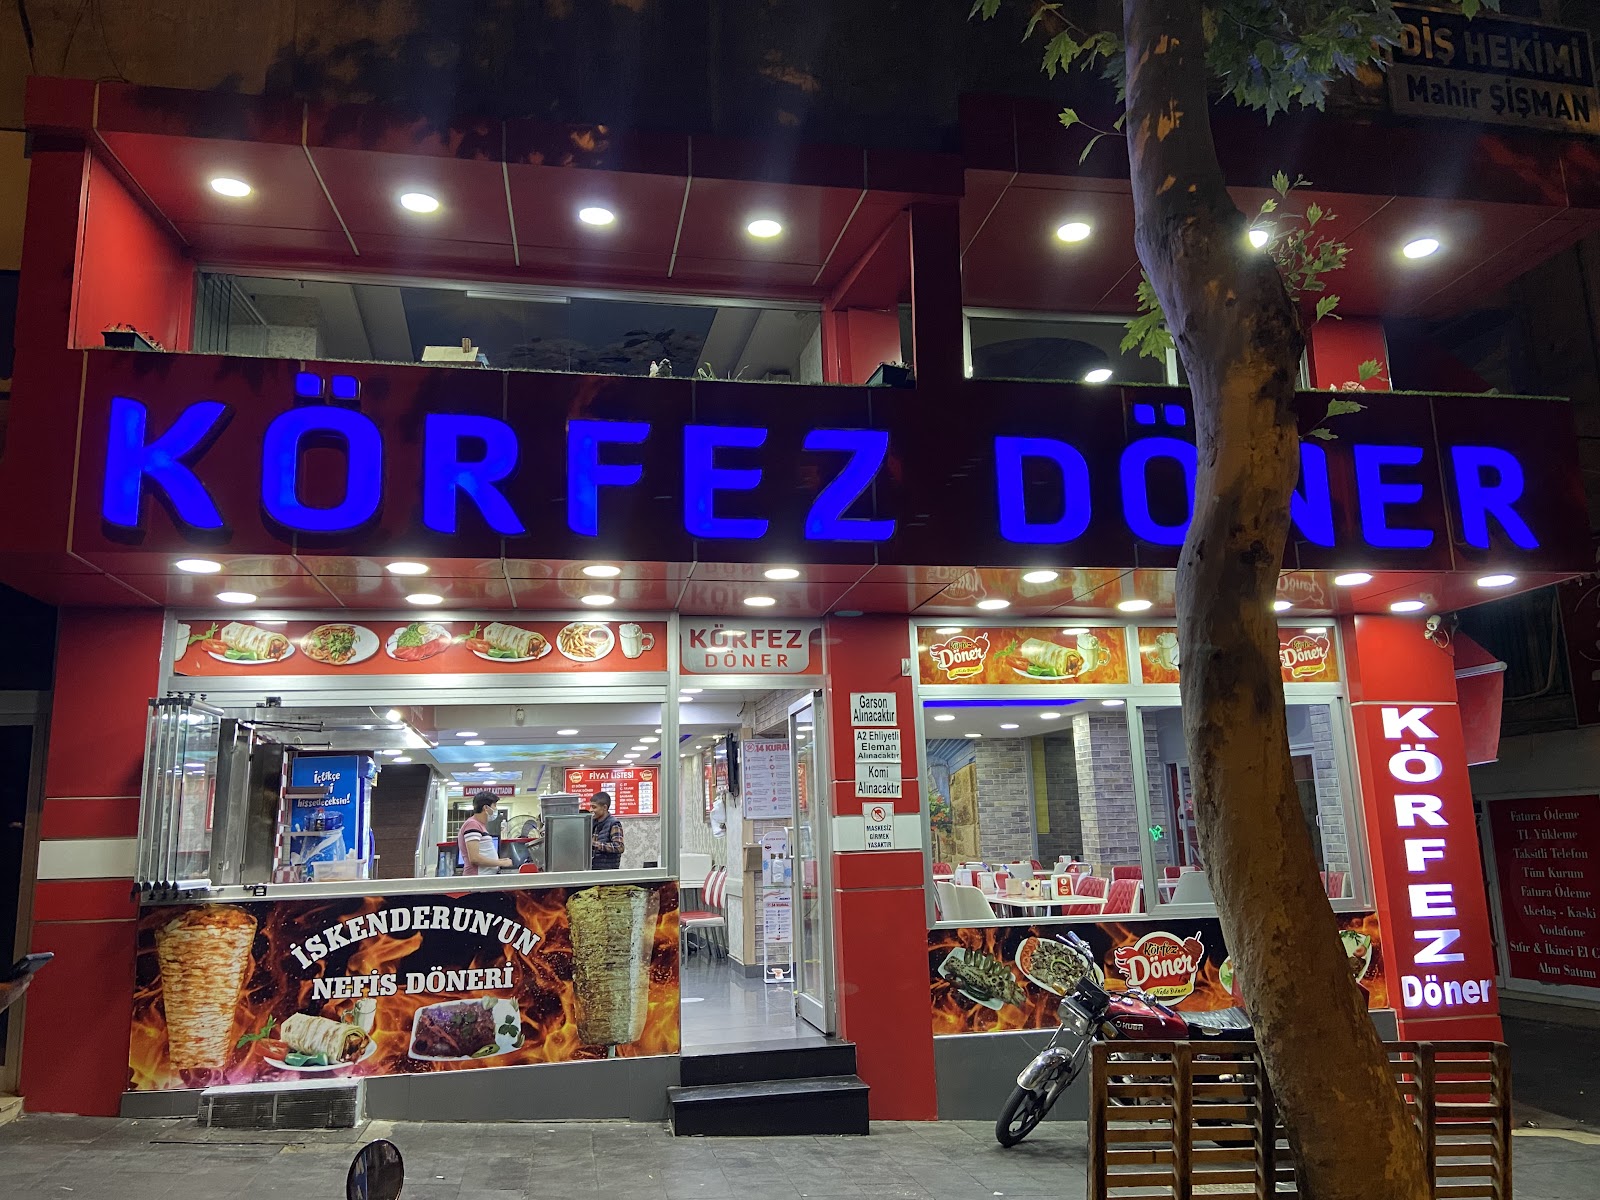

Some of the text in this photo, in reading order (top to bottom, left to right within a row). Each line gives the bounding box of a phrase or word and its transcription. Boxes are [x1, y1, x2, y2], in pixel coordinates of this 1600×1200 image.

[1400, 16, 1582, 79] DİŞ HEKİMİ
[1406, 74, 1590, 123] Mahir ŞİŞMAN
[102, 372, 896, 541] KÖRFEZ
[690, 624, 803, 649] KÖRFEZ
[705, 650, 789, 668] DÖNER
[940, 647, 985, 668] Döner
[1283, 646, 1327, 667] Döner
[859, 695, 888, 709] Garson
[853, 708, 895, 723] Alınacaktır
[857, 731, 900, 743] A2 Ehliyetli
[861, 742, 897, 751] Eleman
[589, 771, 610, 779] FİYAT
[611, 770, 634, 779] LİSTESİ
[868, 766, 889, 778] Komi
[857, 781, 900, 795] Alınacaktır
[1510, 806, 1580, 822] Fatura Ödeme
[866, 824, 892, 832] MASKESİZ
[1381, 707, 1466, 964] KÖRFEZ
[1534, 828, 1578, 841] Yükleme
[1550, 847, 1588, 859] Telefon
[1522, 866, 1584, 879] Tüm Kurum
[1521, 883, 1592, 899] Fatura Ödeme
[1523, 905, 1557, 920] Akedaş
[1567, 906, 1597, 919] Kaski
[289, 905, 541, 970] İSKENDERUN'UN
[1539, 924, 1586, 938] Vodafone
[1533, 942, 1542, 954] &
[1544, 940, 1574, 957] İkinci
[1577, 945, 1589, 958] El
[1126, 954, 1196, 986] Döner
[1538, 962, 1597, 979] Alım Satımı
[312, 961, 514, 1000] NEFİS DÖNERİ
[1400, 975, 1492, 1008] Döner
